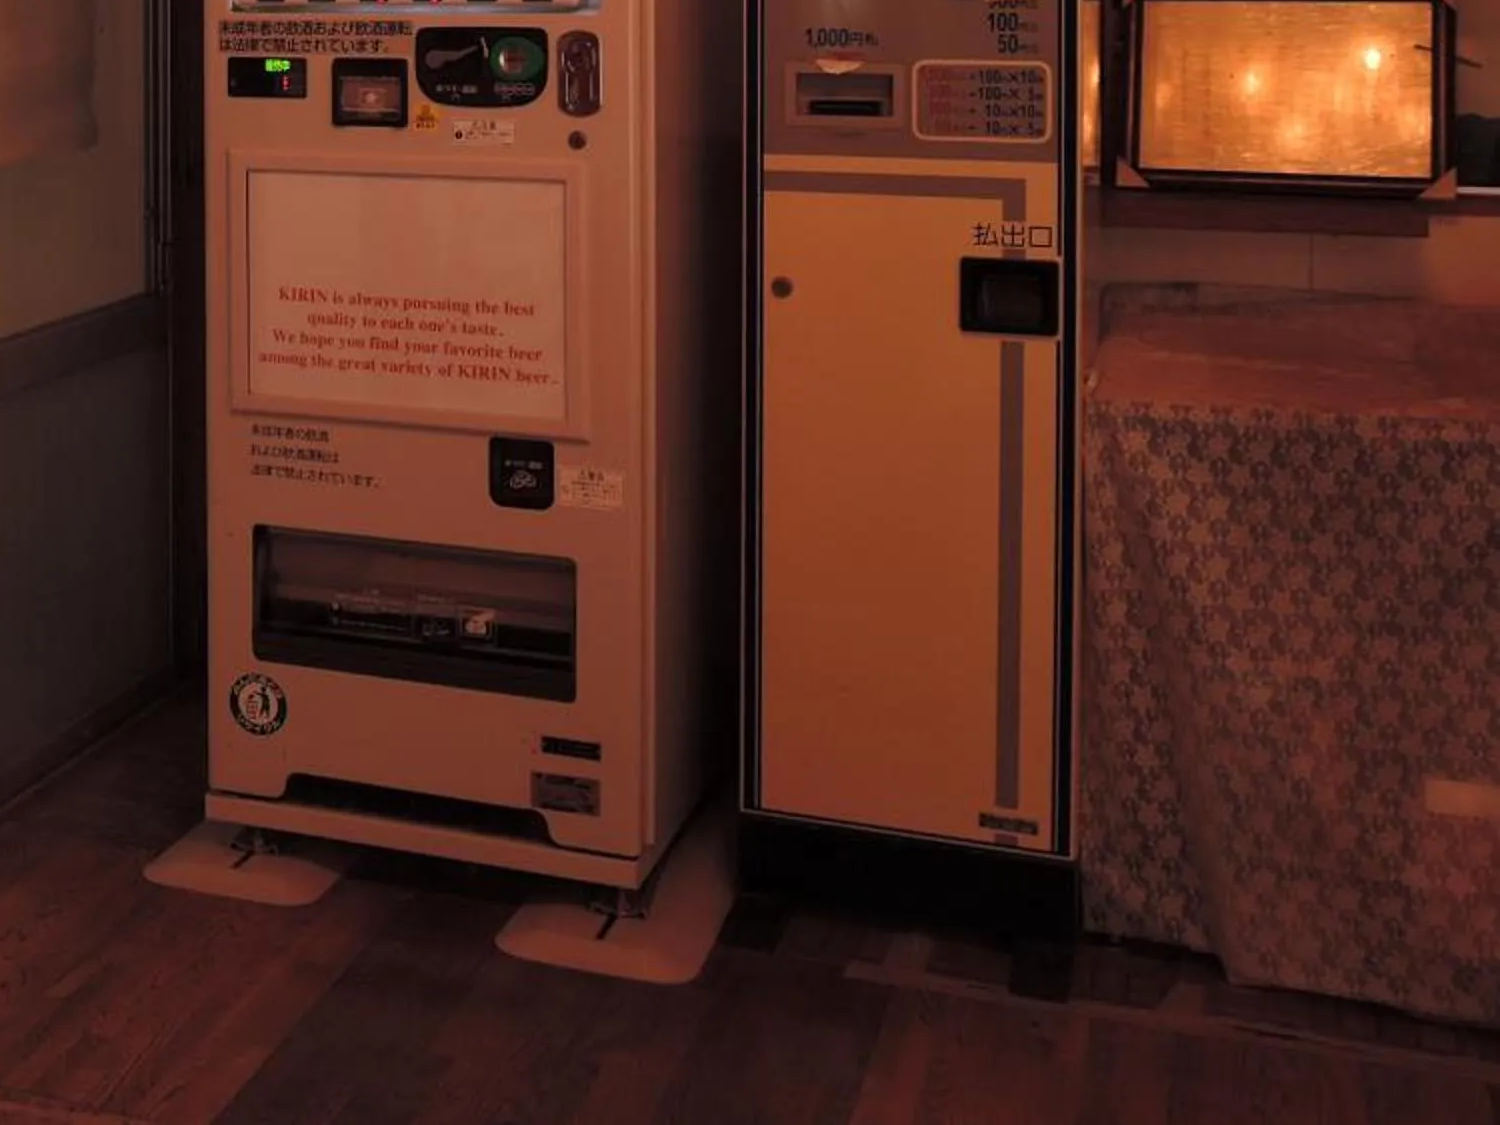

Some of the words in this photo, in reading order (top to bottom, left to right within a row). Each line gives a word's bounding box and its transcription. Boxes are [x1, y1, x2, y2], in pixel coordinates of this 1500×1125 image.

[972, 221, 1053, 248] 払出口
[279, 286, 328, 304] KIRIN
[332, 289, 344, 304] is
[348, 291, 399, 311] always
[403, 295, 470, 316] pursuing
[475, 299, 499, 315] the
[504, 300, 535, 317] best
[362, 315, 377, 328] to
[381, 315, 415, 331] each
[273, 329, 296, 346] We
[300, 331, 334, 349] hope
[339, 336, 366, 351] you
[369, 334, 399, 352] find
[404, 341, 440, 358] your
[444, 340, 504, 360] favorite
[509, 345, 543, 362] beer
[258, 351, 308, 370] among
[311, 353, 334, 369] the
[339, 356, 376, 374] great
[381, 359, 433, 379] variety
[438, 362, 454, 378] of
[458, 363, 512, 383] KIRIN
